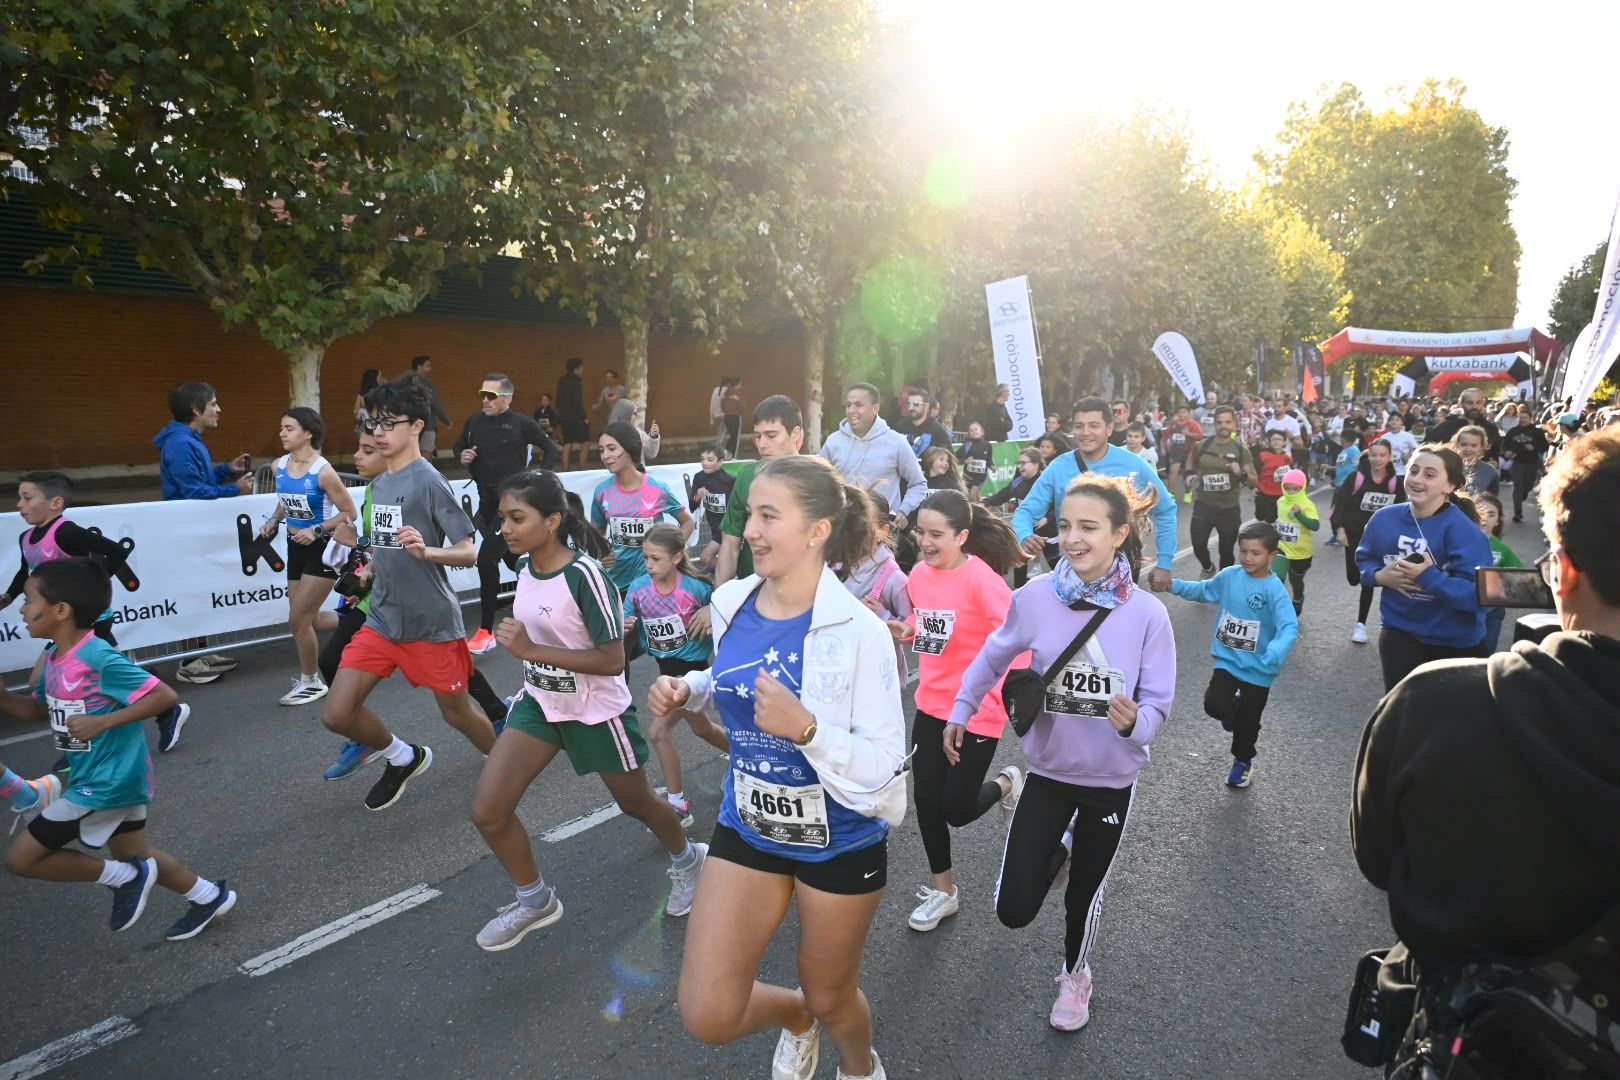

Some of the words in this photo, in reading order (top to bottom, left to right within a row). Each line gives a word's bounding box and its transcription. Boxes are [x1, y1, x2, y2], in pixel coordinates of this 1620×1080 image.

[1431, 357, 1508, 369] kutxabank
[374, 512, 393, 528] 5492
[620, 523, 645, 534] 5118
[923, 617, 947, 635] 4662
[1224, 619, 1248, 636] 3871
[1062, 671, 1111, 694] 4261
[750, 789, 804, 818] 4661
